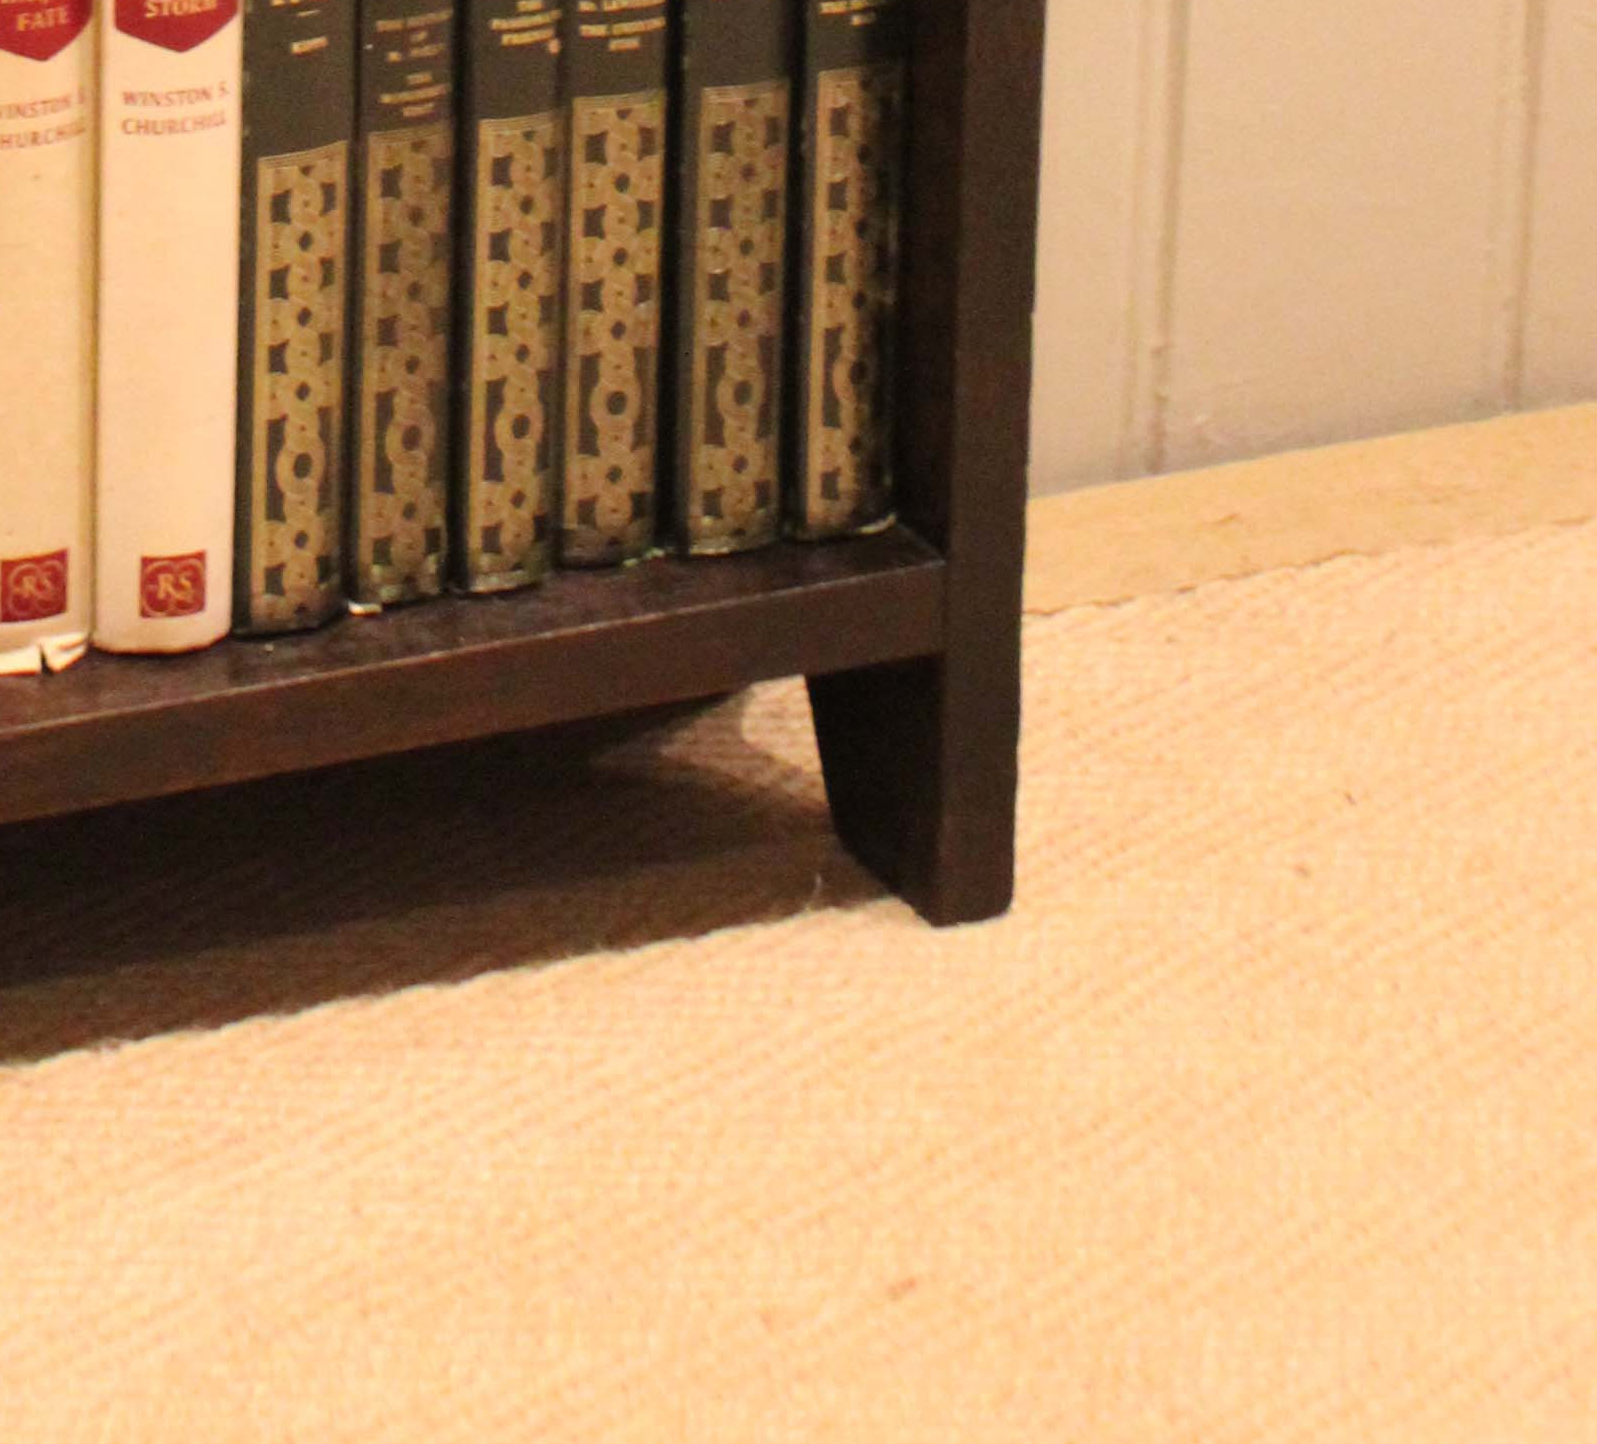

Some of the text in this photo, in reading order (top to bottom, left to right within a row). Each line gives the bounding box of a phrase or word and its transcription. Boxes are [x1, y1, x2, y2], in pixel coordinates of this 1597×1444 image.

[16, 5, 71, 33] FATE
[121, 86, 213, 109] WINSTON
[121, 111, 227, 138] CHURCHILL
